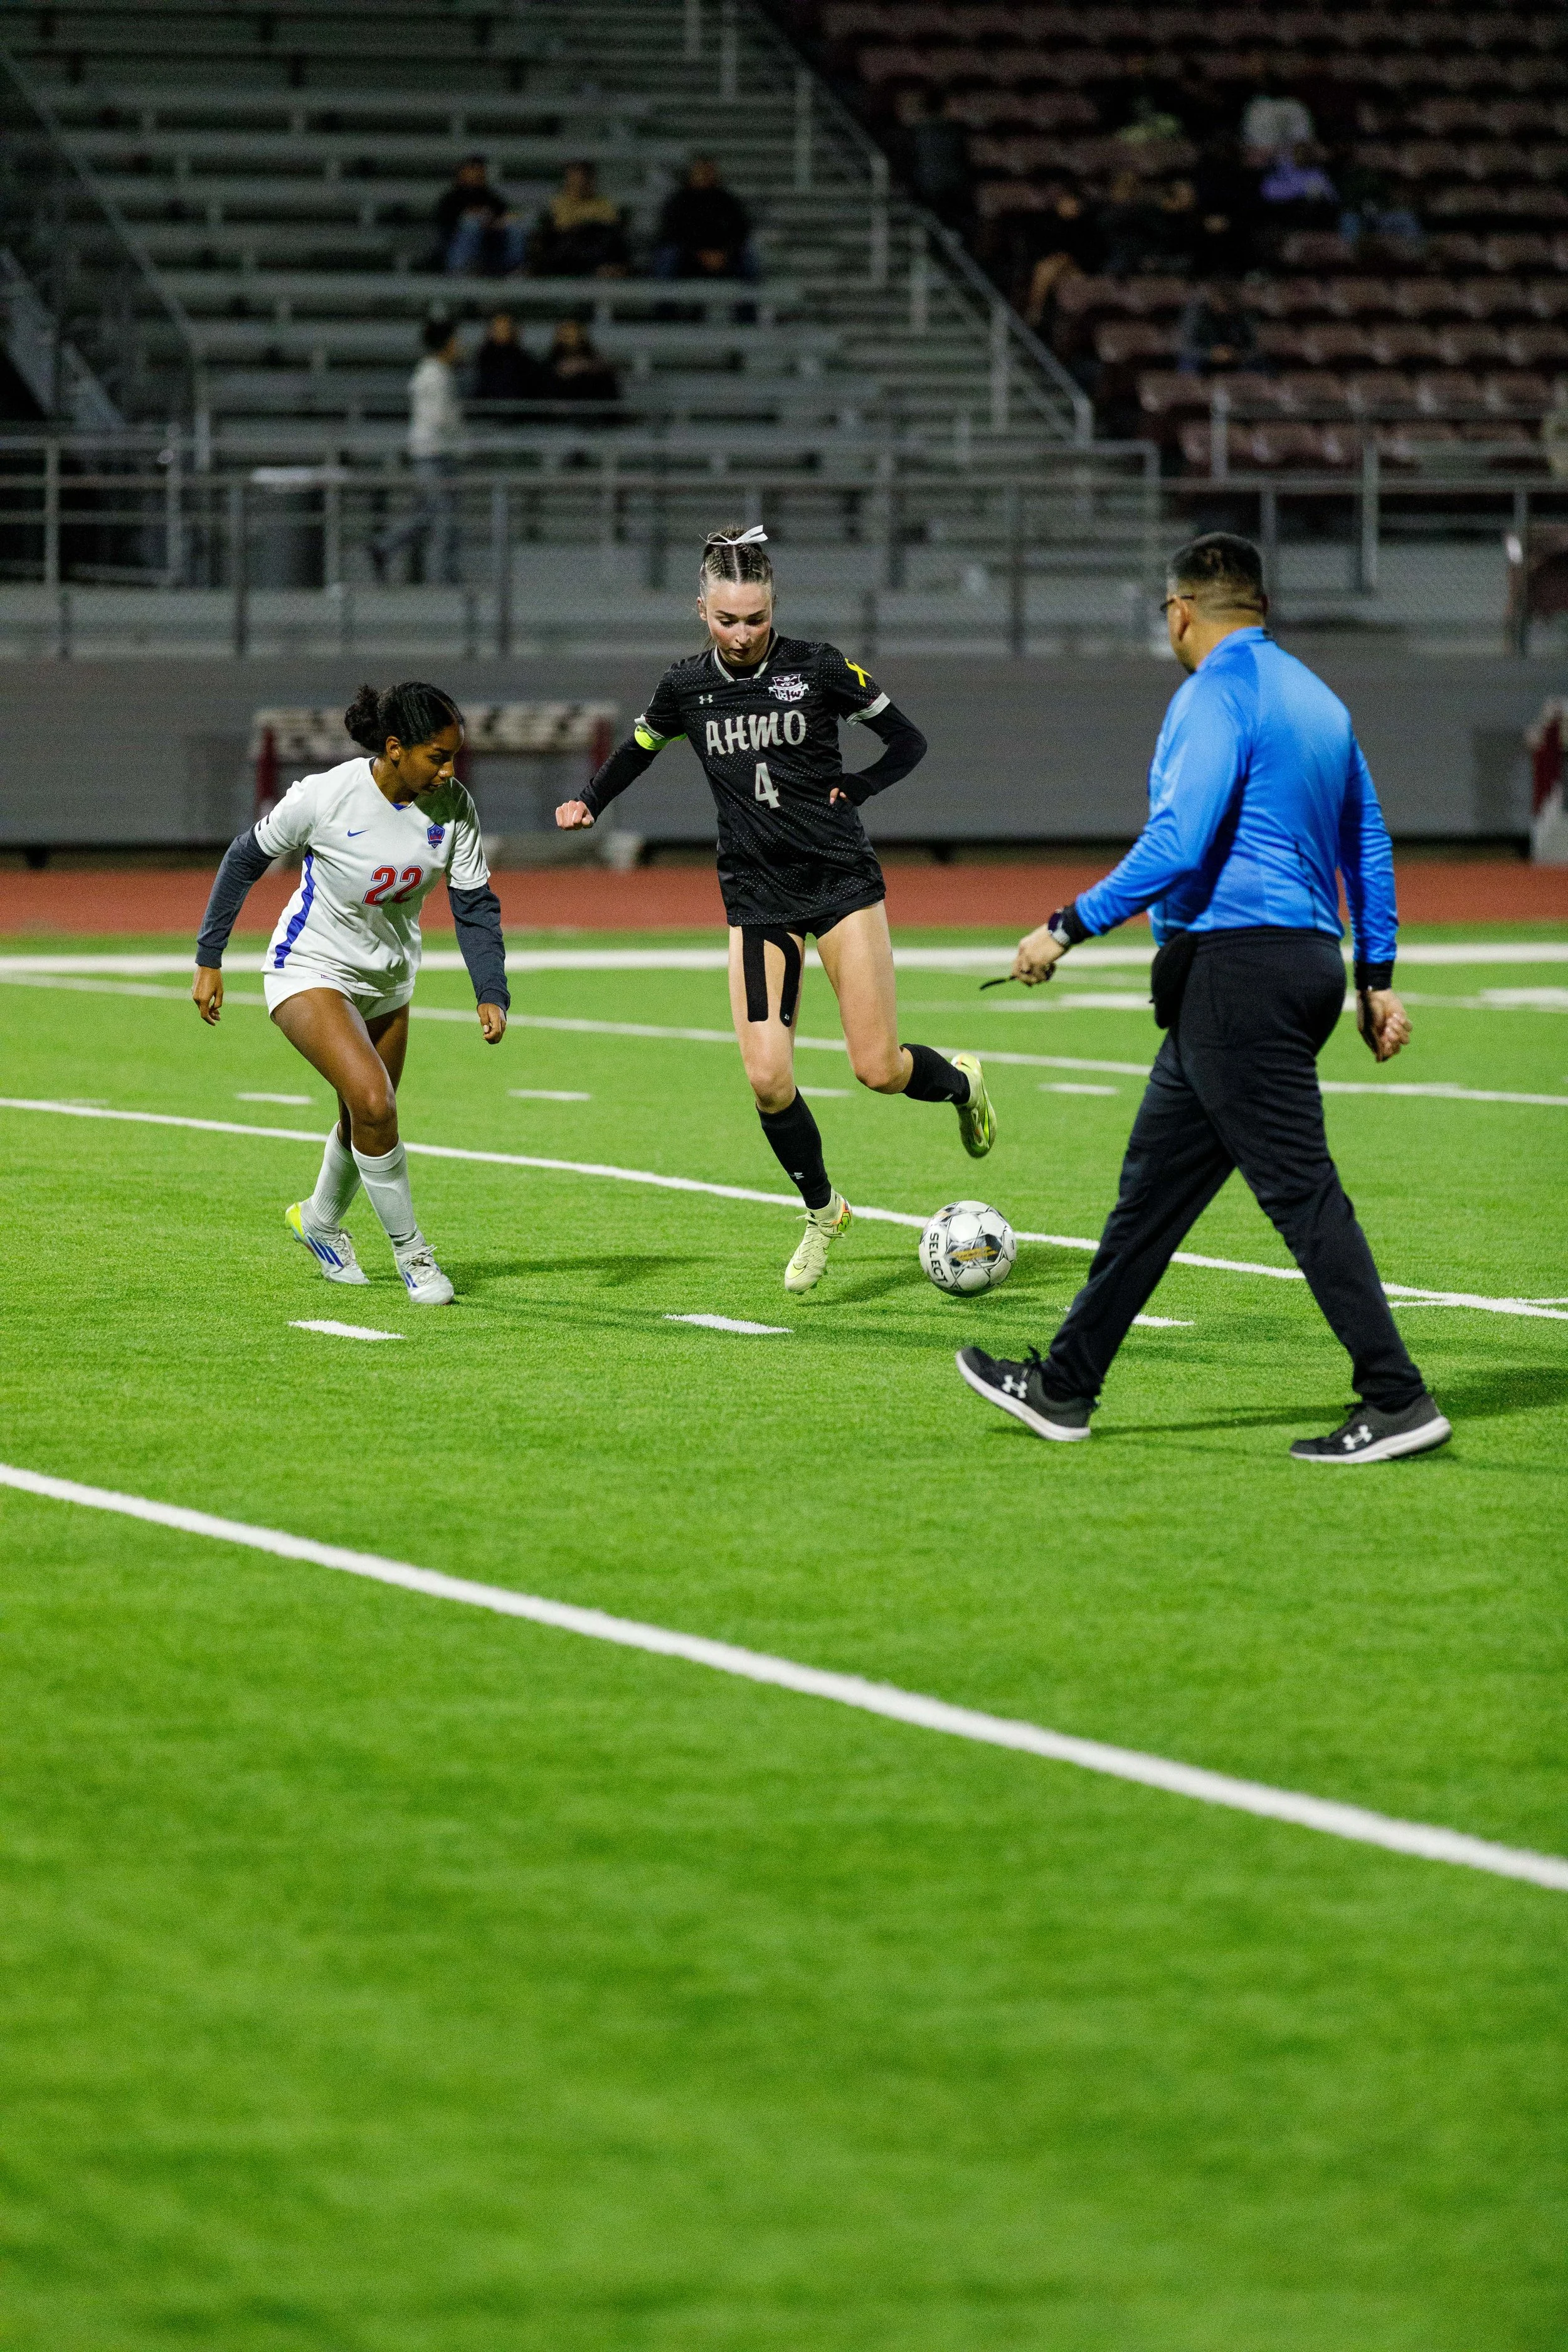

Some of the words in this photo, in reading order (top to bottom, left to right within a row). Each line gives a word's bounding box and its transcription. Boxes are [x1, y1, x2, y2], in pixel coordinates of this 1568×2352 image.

[706, 710, 806, 756] AHMO
[755, 763, 781, 808] 4
[362, 865, 424, 906] 22
[929, 1232, 948, 1283] SELECT
